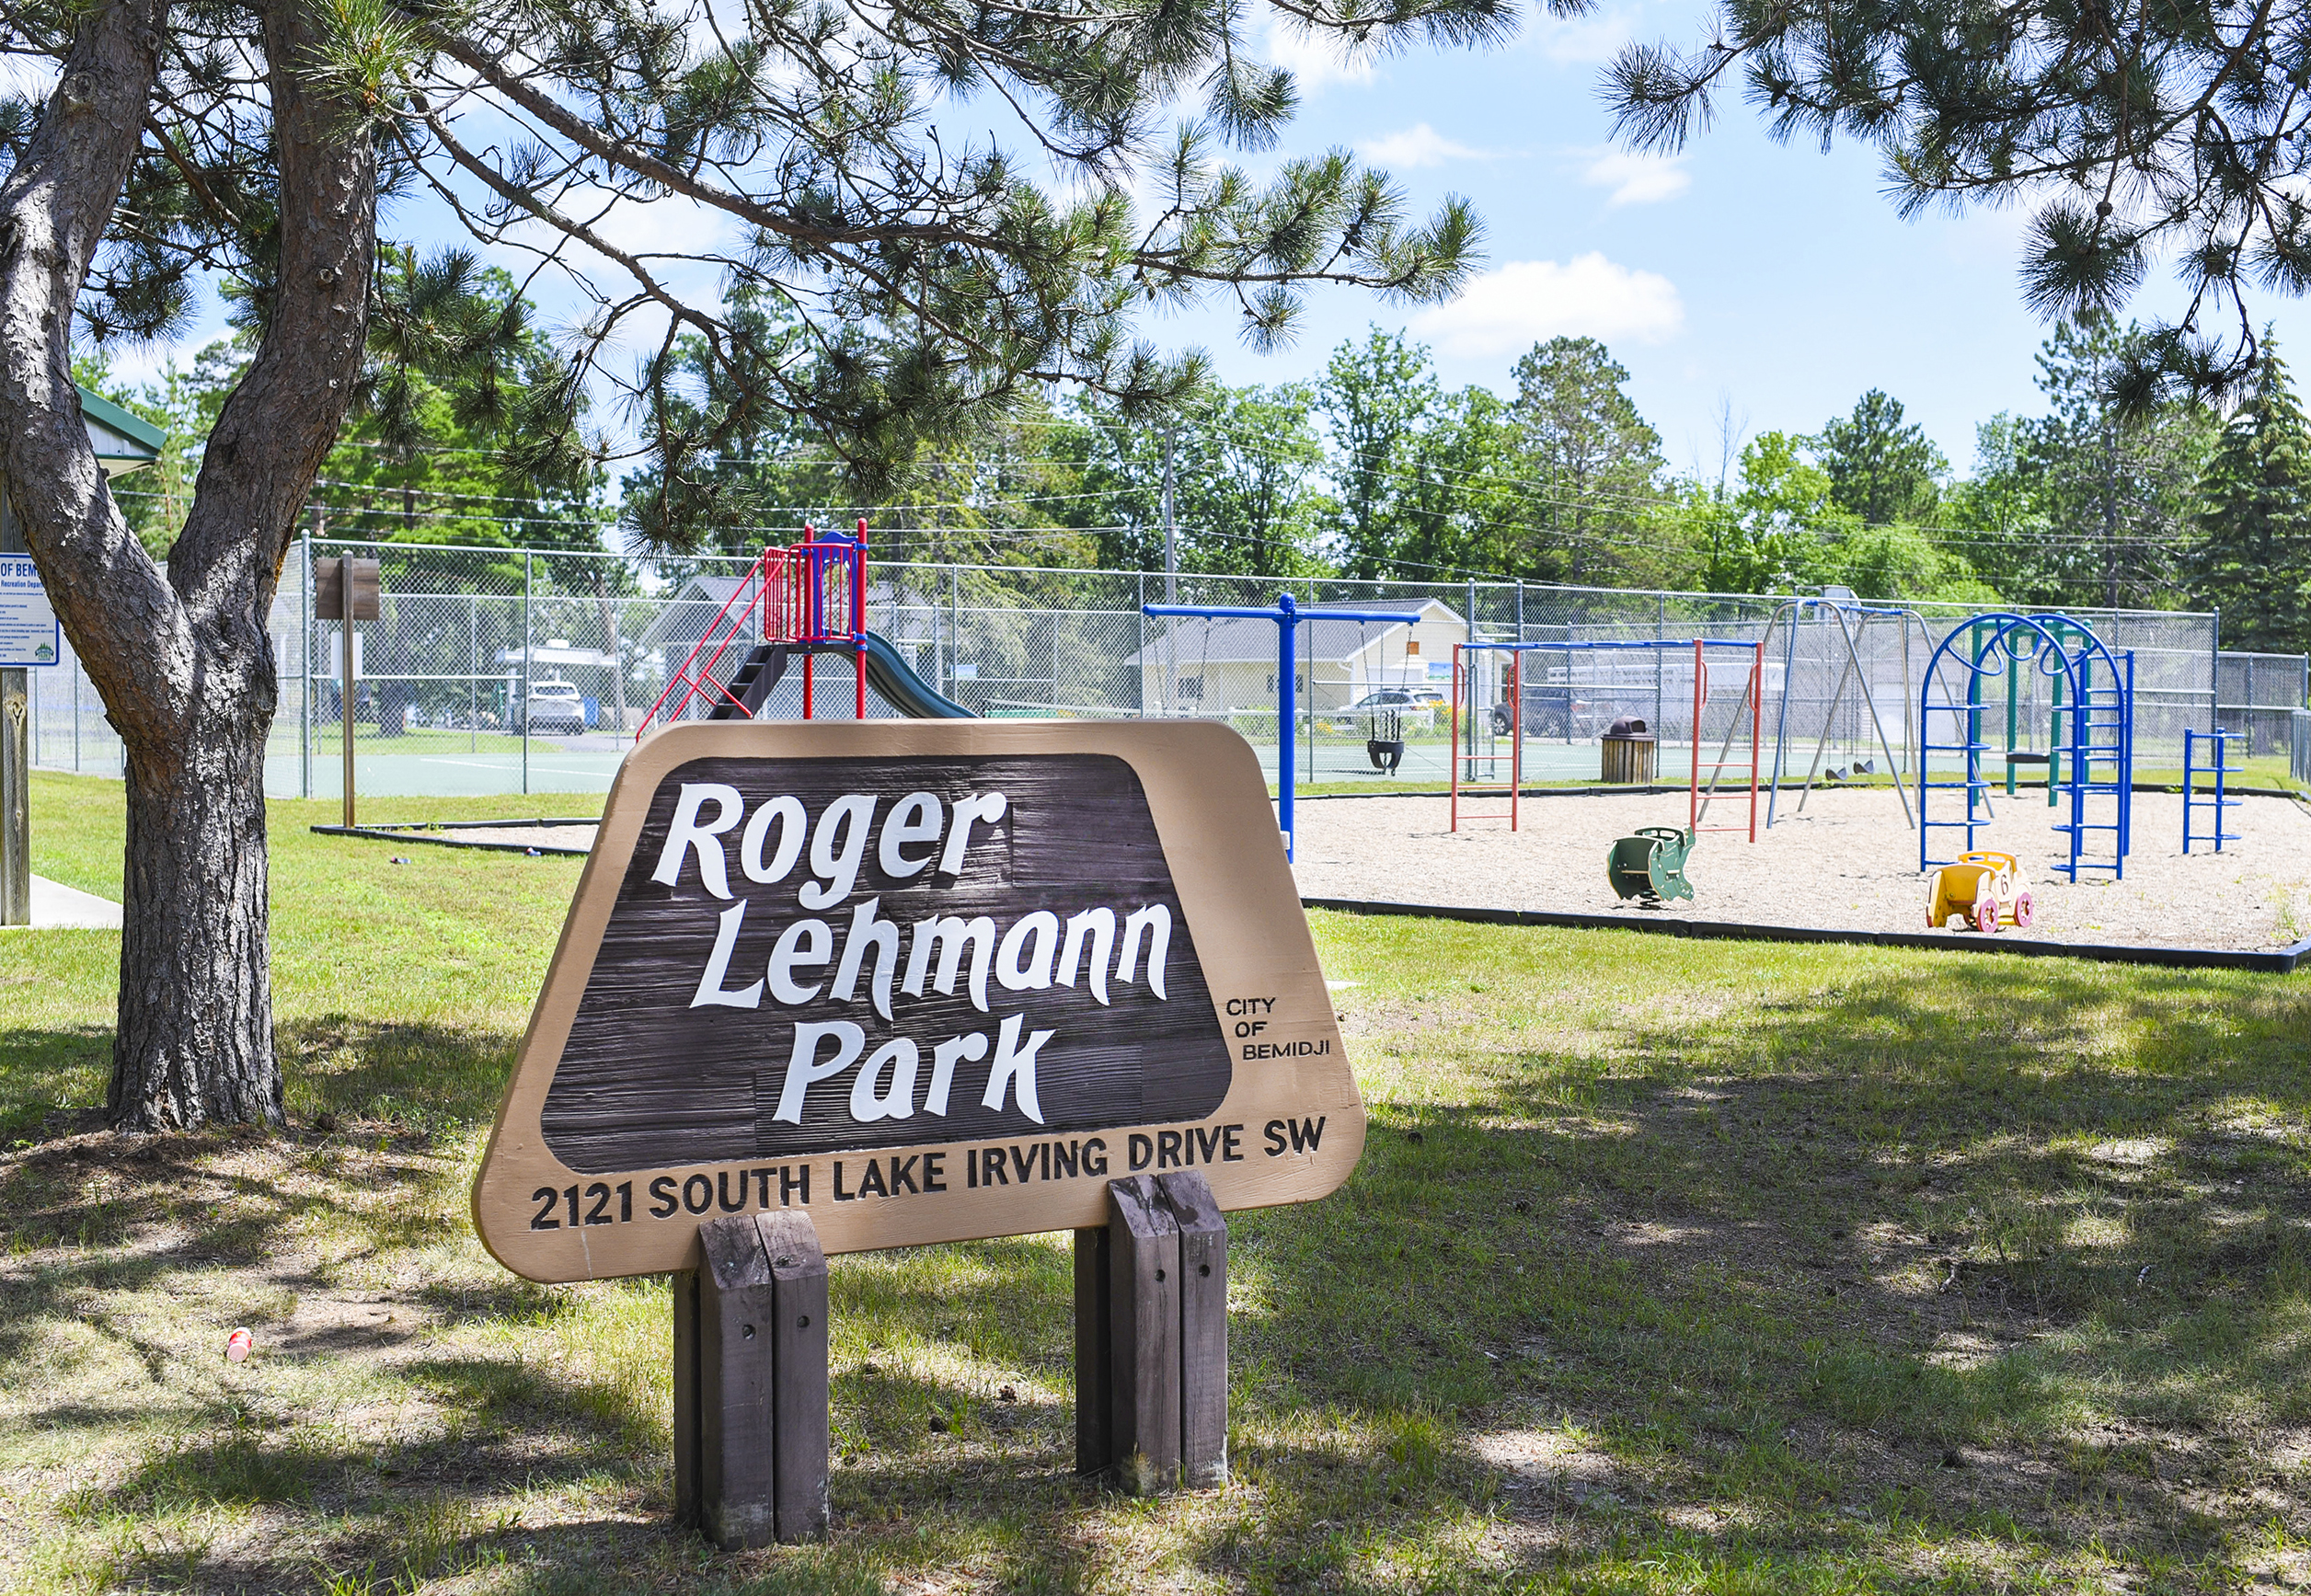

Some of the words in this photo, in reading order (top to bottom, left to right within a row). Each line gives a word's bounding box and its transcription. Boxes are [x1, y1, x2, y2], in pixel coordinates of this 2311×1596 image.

[1, 562, 13, 577] OF
[1, 580, 26, 588] Recreation
[650, 783, 1007, 910] Roger
[2001, 874, 2008, 896] 6
[689, 898, 1171, 1022] Lehmann
[1226, 997, 1276, 1016] CITY
[1235, 1021, 1268, 1038] OF
[1243, 1039, 1329, 1061] BEMIDJI
[772, 1013, 1056, 1125] Park
[531, 1180, 632, 1230] 2121
[649, 1165, 811, 1219] SOUTH
[833, 1152, 947, 1201] LAKE
[967, 1137, 1108, 1188] IRVING
[1128, 1124, 1244, 1171] DRIVE
[1263, 1116, 1326, 1157] SW
